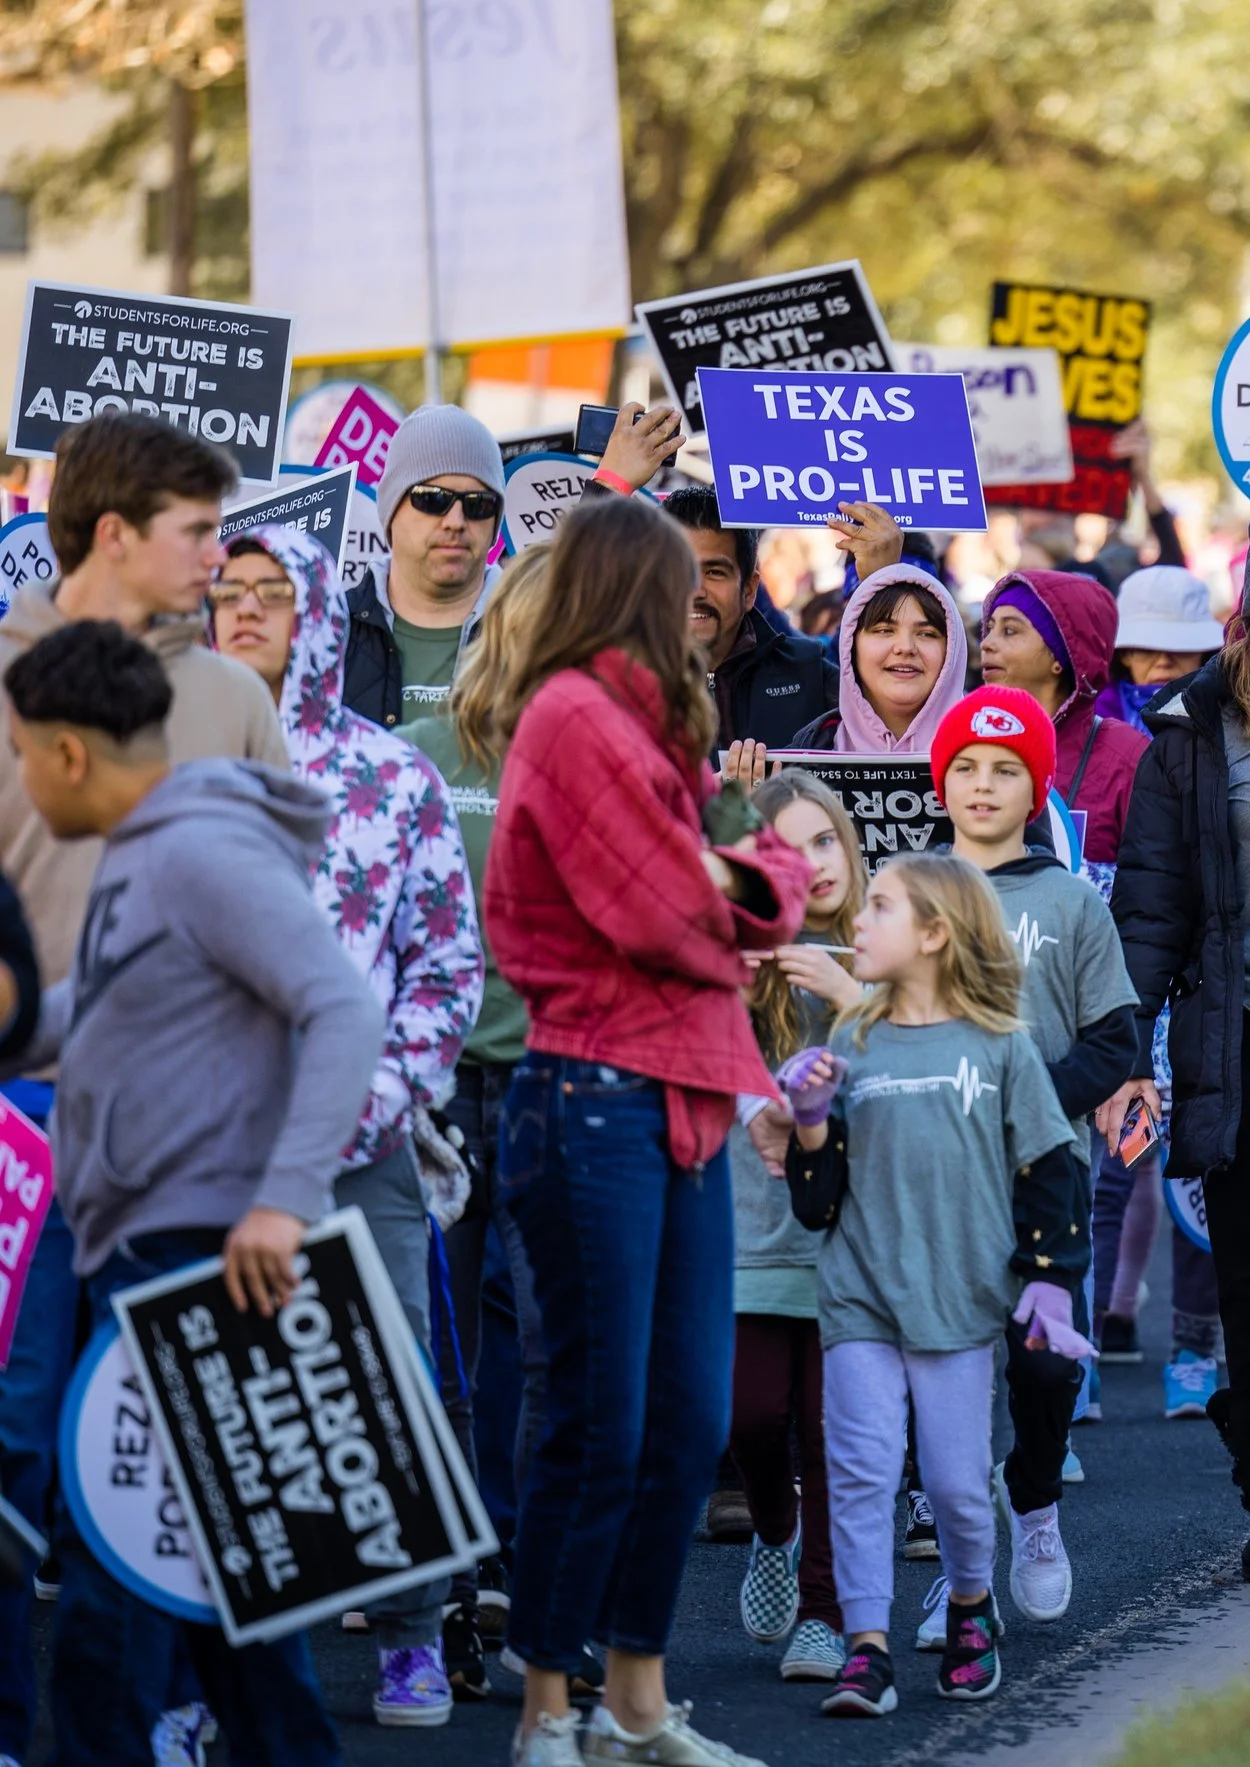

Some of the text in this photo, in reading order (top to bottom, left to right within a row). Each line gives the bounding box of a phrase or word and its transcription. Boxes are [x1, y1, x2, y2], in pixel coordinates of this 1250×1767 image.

[94, 304, 250, 337] STUDENTSFORLIFE.ORG
[670, 295, 851, 350] THE FUTURE IS
[992, 287, 1148, 361] JESUS
[52, 323, 264, 370] THE FUTURE IS
[719, 326, 826, 369] ANTI-
[86, 355, 218, 400] ANTI-
[753, 383, 915, 422] TEXAS
[824, 429, 868, 464] IS
[728, 464, 970, 506] PRO-LIFE
[222, 489, 325, 536] STUDENTSFORLIFE.ORG
[313, 508, 332, 531] IS
[844, 770, 861, 780] TO
[863, 770, 887, 780] LIFE
[890, 770, 917, 780] TEXT
[177, 1304, 300, 1593] THE FUTURE IS
[242, 1345, 335, 1514] ANTI-
